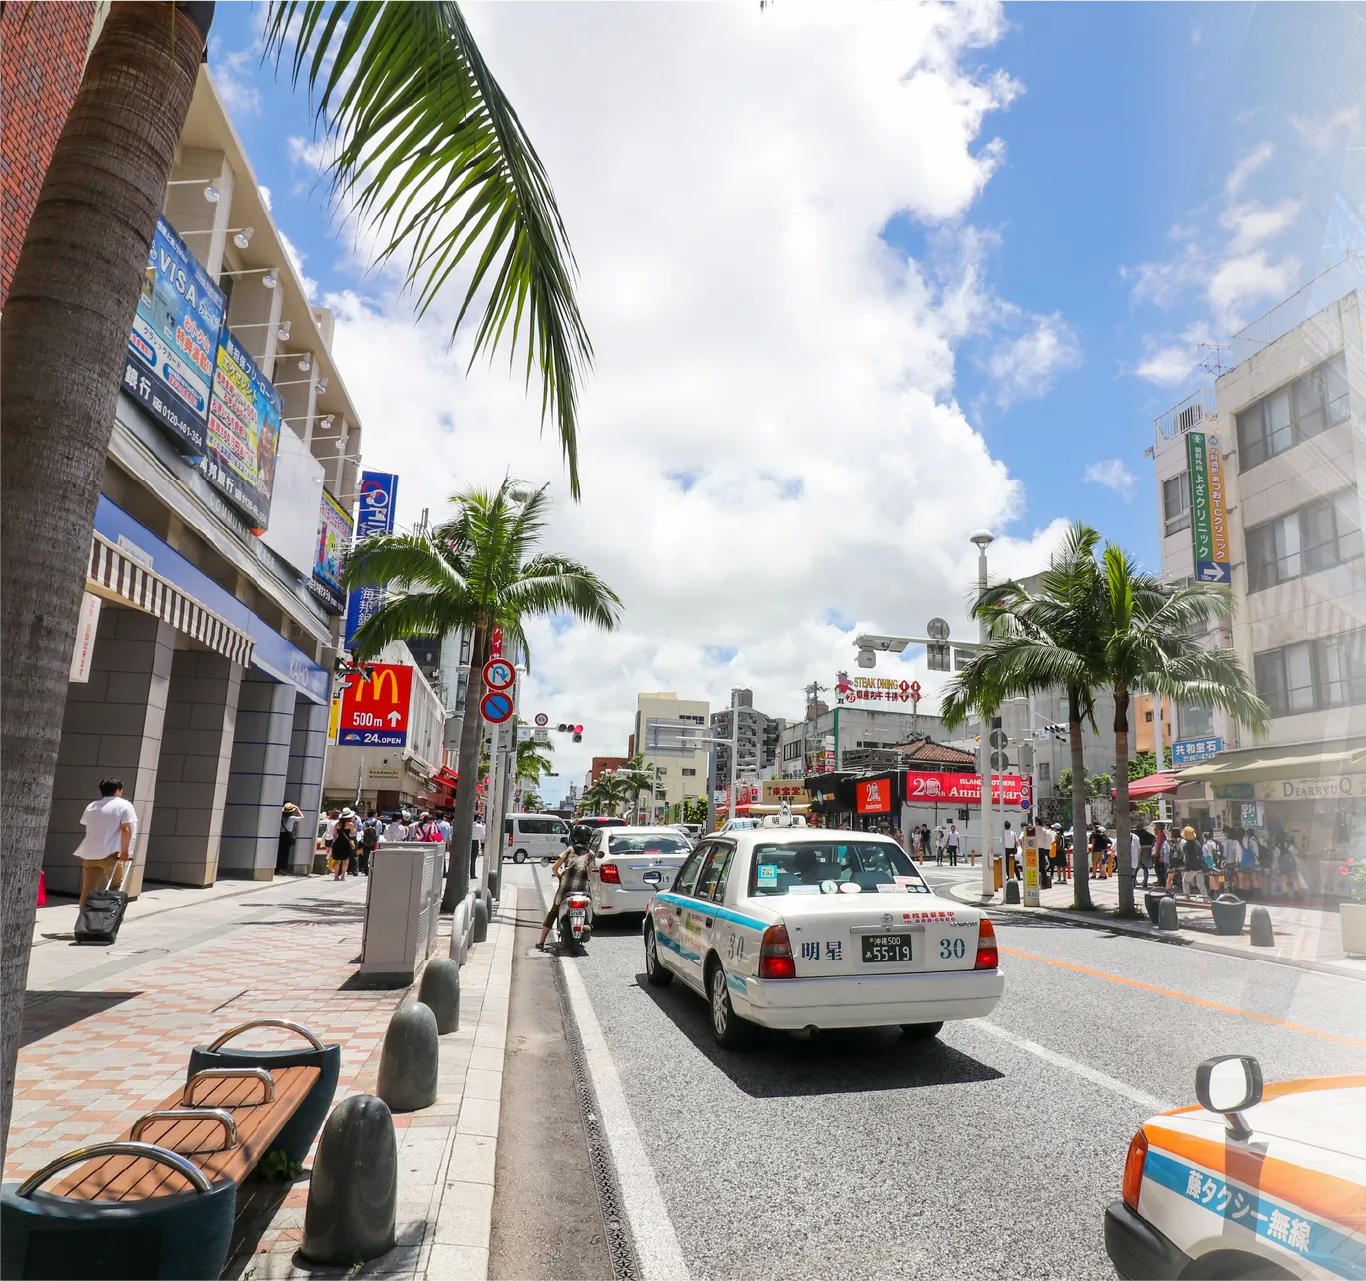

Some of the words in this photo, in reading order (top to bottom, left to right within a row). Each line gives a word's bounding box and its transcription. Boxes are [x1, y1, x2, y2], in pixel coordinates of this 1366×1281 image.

[160, 246, 196, 310] VISA
[162, 405, 203, 446] 0120-461-354
[854, 677, 876, 688] STEAK
[877, 679, 899, 689] DINING
[353, 712, 382, 727] 500m
[1176, 741, 1216, 755] 共和宝石
[773, 787, 801, 796] 東宝堂
[728, 933, 744, 962] 30
[802, 941, 843, 961] 明星
[874, 946, 910, 961] 55-19
[940, 938, 965, 959] 30
[1186, 1170, 1311, 1253] 藤タクシー無線
